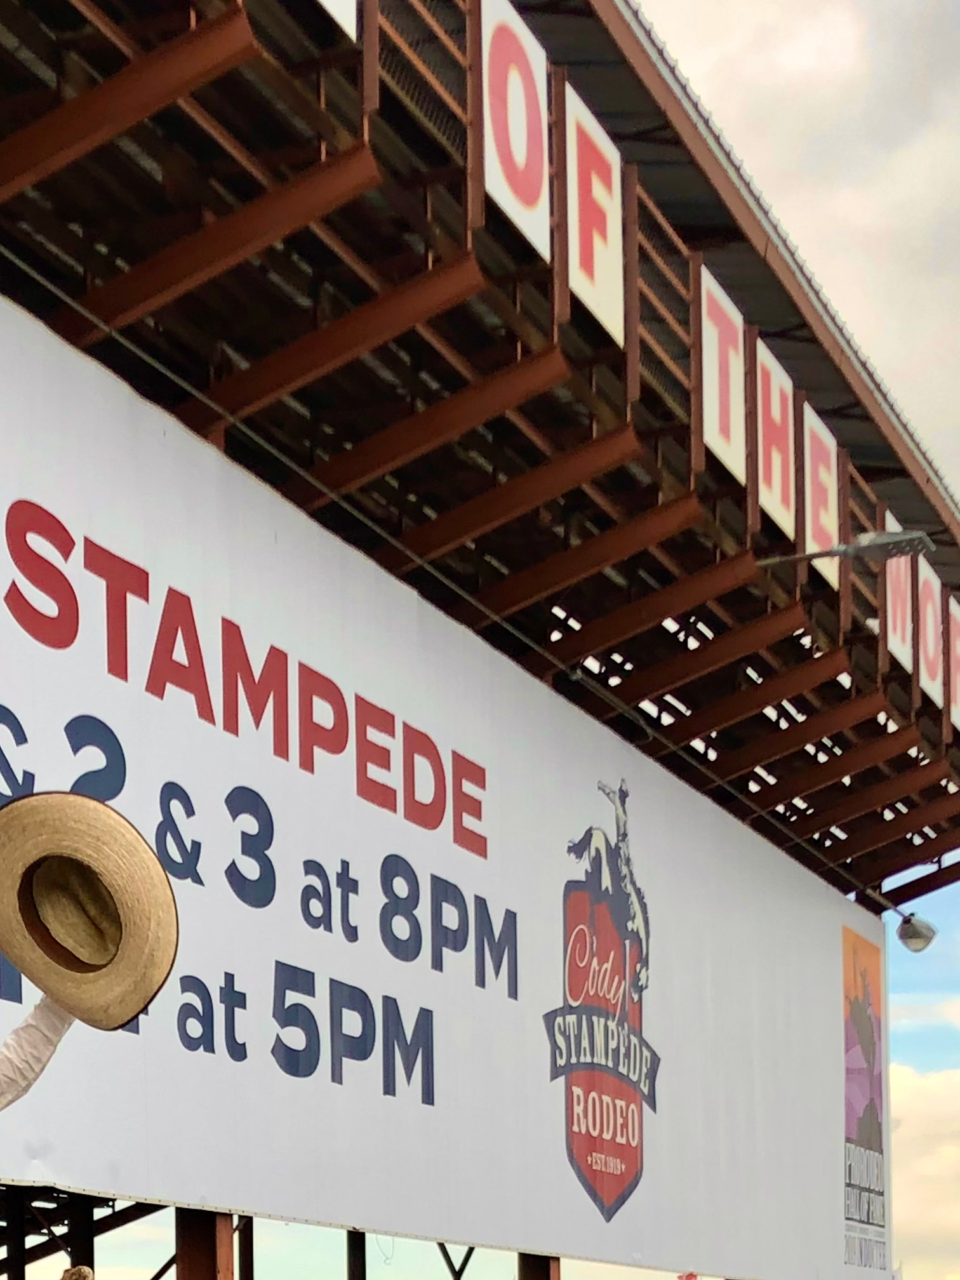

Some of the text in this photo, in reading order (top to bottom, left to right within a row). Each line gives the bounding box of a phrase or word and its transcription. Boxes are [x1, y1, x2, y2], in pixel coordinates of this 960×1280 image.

[488, 20, 613, 282] OF
[706, 288, 837, 549] THE
[3, 499, 488, 860] STAMPEDE
[64, 715, 127, 802] 2
[155, 782, 205, 886] &
[224, 786, 276, 908] 3
[300, 859, 359, 943] at
[379, 854, 518, 1002] 8PM
[177, 971, 248, 1062] at
[271, 960, 435, 1106] 5PM
[565, 924, 627, 1024] Cody
[554, 1013, 651, 1096] STAMPEDE
[571, 1085, 639, 1148] RODEO
